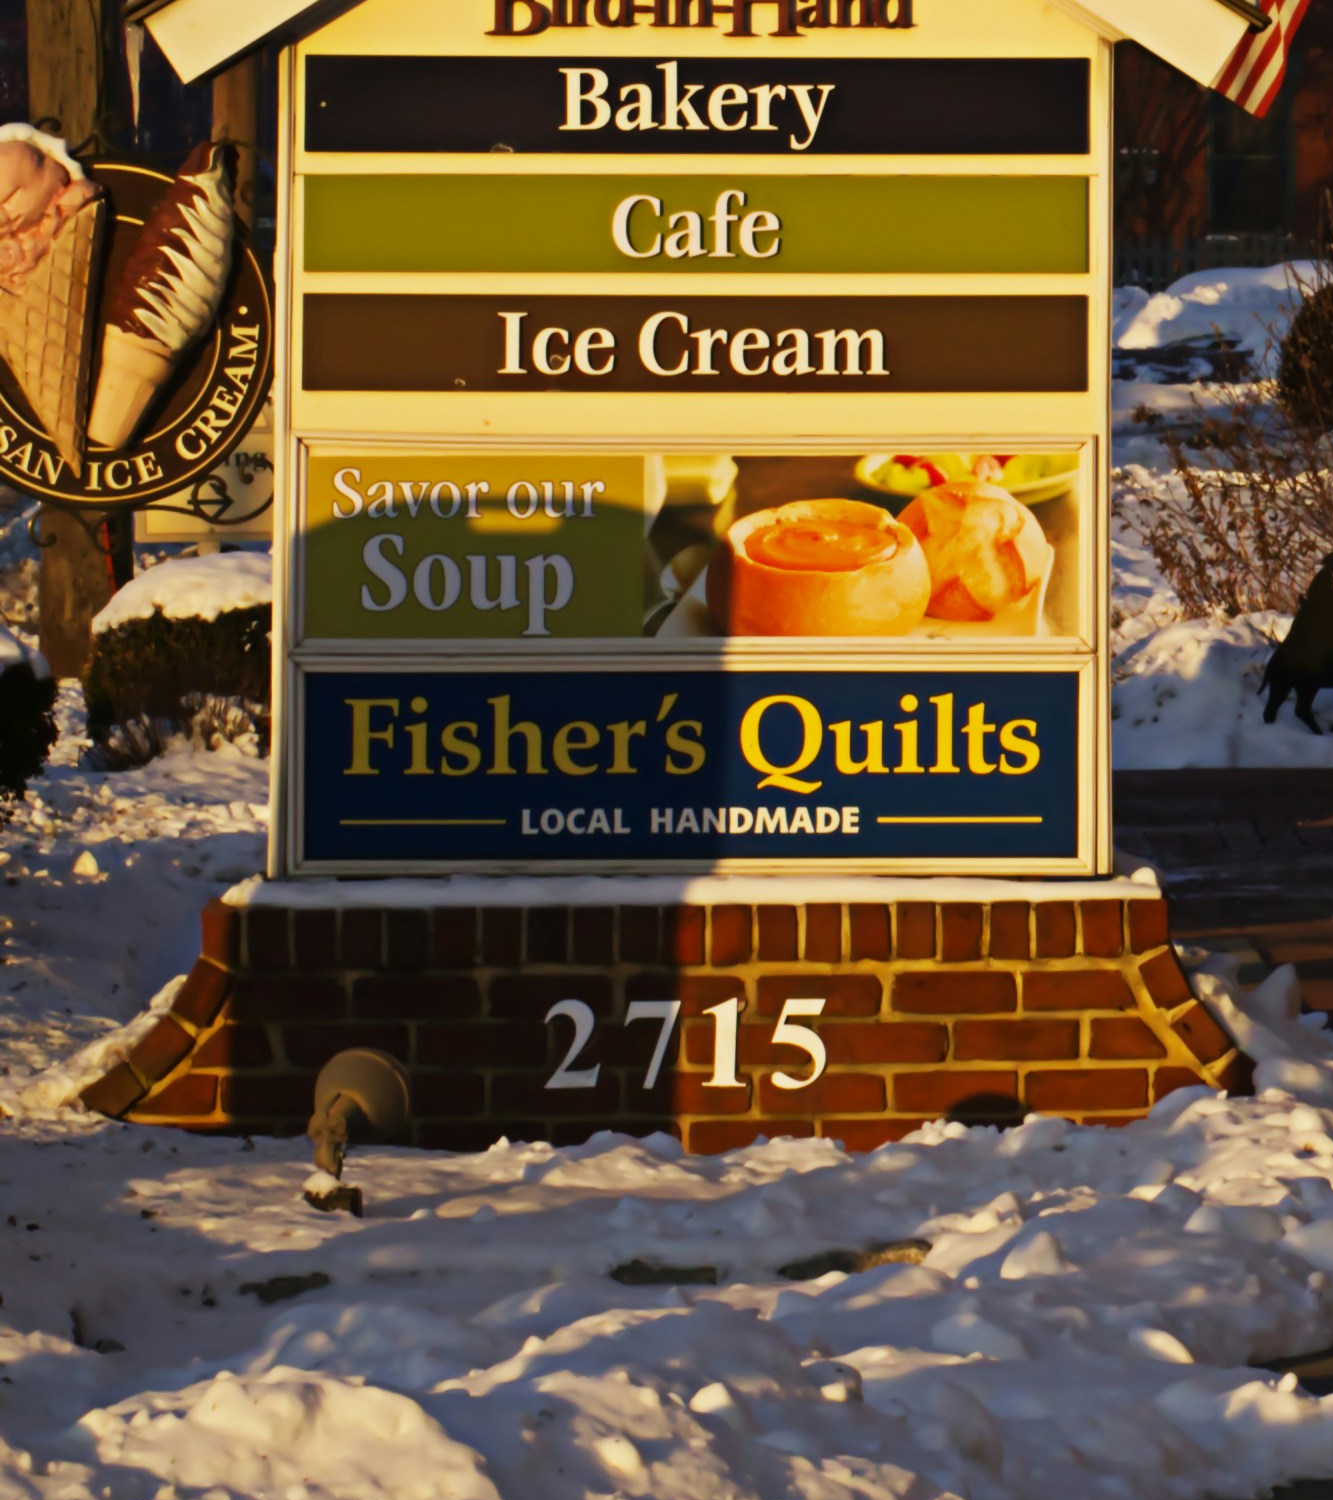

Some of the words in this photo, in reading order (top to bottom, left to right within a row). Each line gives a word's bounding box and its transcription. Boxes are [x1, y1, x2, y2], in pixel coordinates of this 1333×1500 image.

[557, 60, 836, 151] Bakery
[610, 189, 782, 260] Cafe
[496, 311, 616, 376] Ice
[637, 311, 890, 376] Cream
[84, 450, 164, 492] ICE
[174, 322, 261, 462] CREAM
[332, 467, 489, 519] Savor
[505, 478, 606, 519] our
[360, 532, 575, 637] Soup
[341, 691, 707, 777] Fisher's
[738, 692, 1041, 795] Quilts
[520, 806, 631, 836] LOCAL
[649, 806, 861, 835] HANDMADE
[544, 997, 827, 1090] 2715
